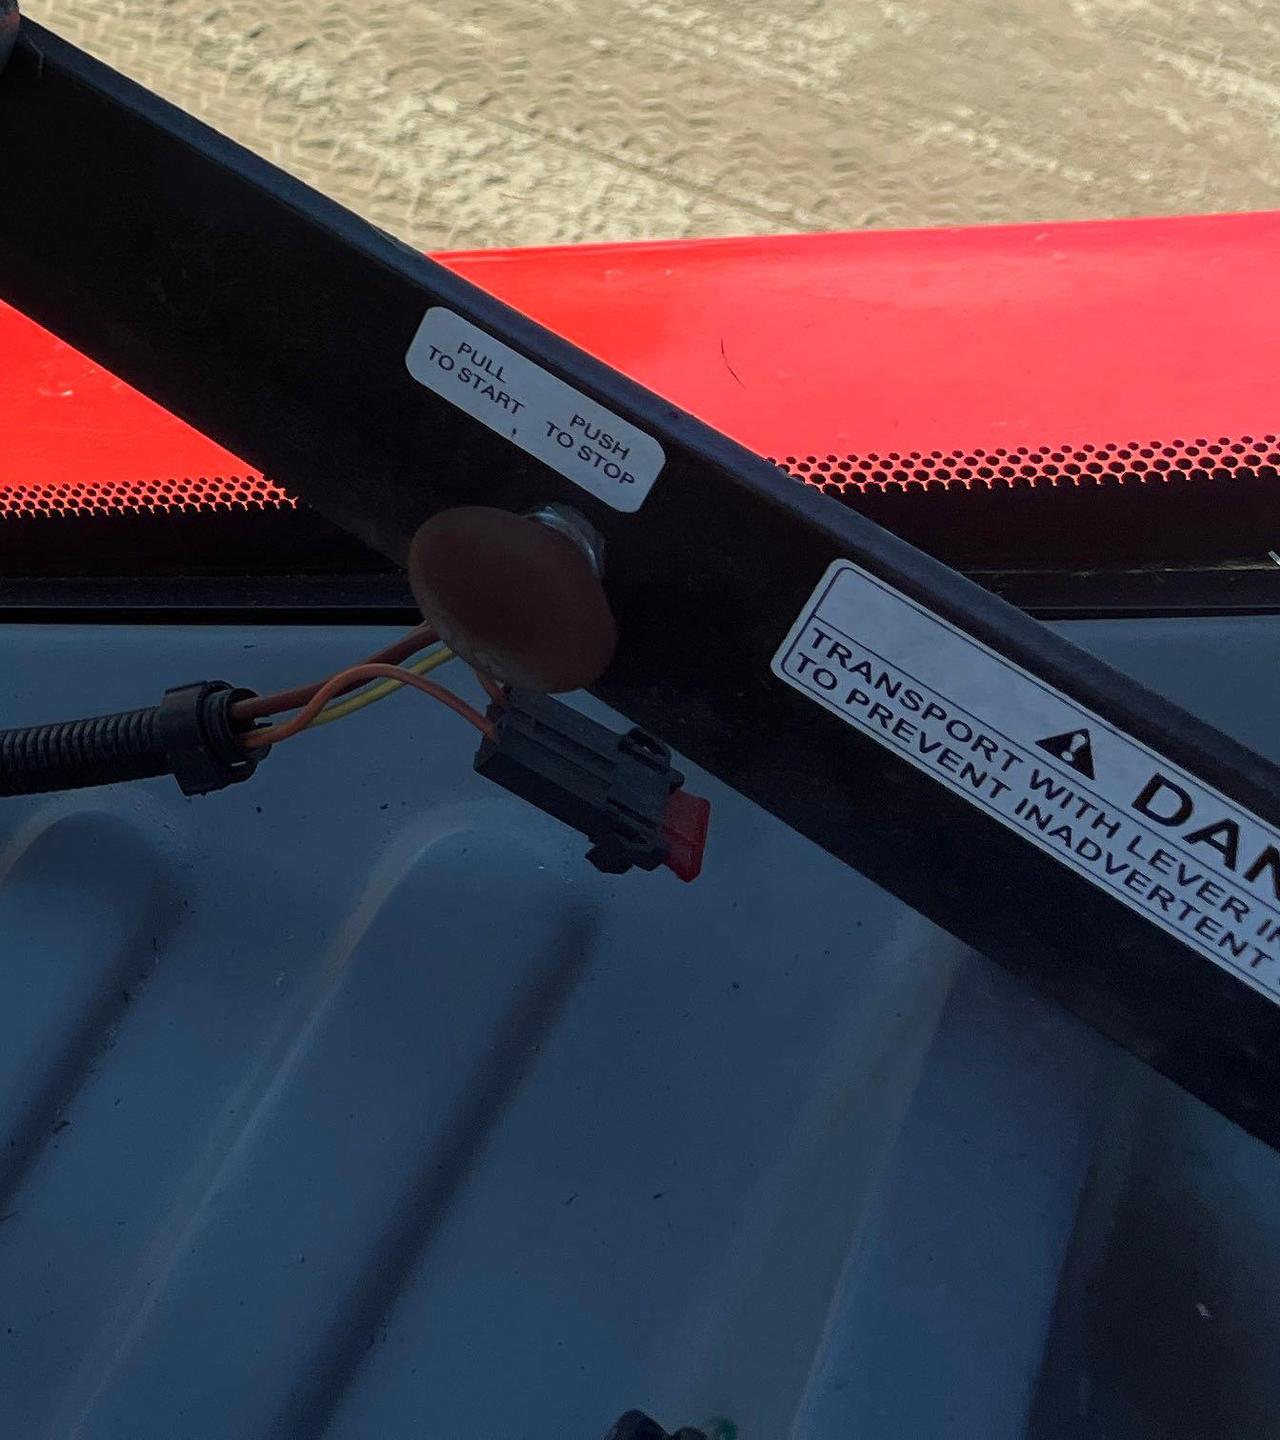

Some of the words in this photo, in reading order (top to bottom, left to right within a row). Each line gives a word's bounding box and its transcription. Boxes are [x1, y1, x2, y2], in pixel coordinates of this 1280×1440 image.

[428, 345, 455, 372] TO
[457, 367, 525, 415] START
[457, 341, 506, 384] PULL
[546, 421, 574, 449] TO
[577, 446, 635, 485] STOP
[570, 414, 630, 460] PUSH
[796, 653, 838, 691] TO
[844, 687, 1013, 800] PREVENT
[1014, 797, 1274, 968] INADVERTENT
[812, 628, 1024, 774] TRANSPORT
[1028, 767, 1123, 840] WITH
[1127, 834, 1252, 926] LEVER
